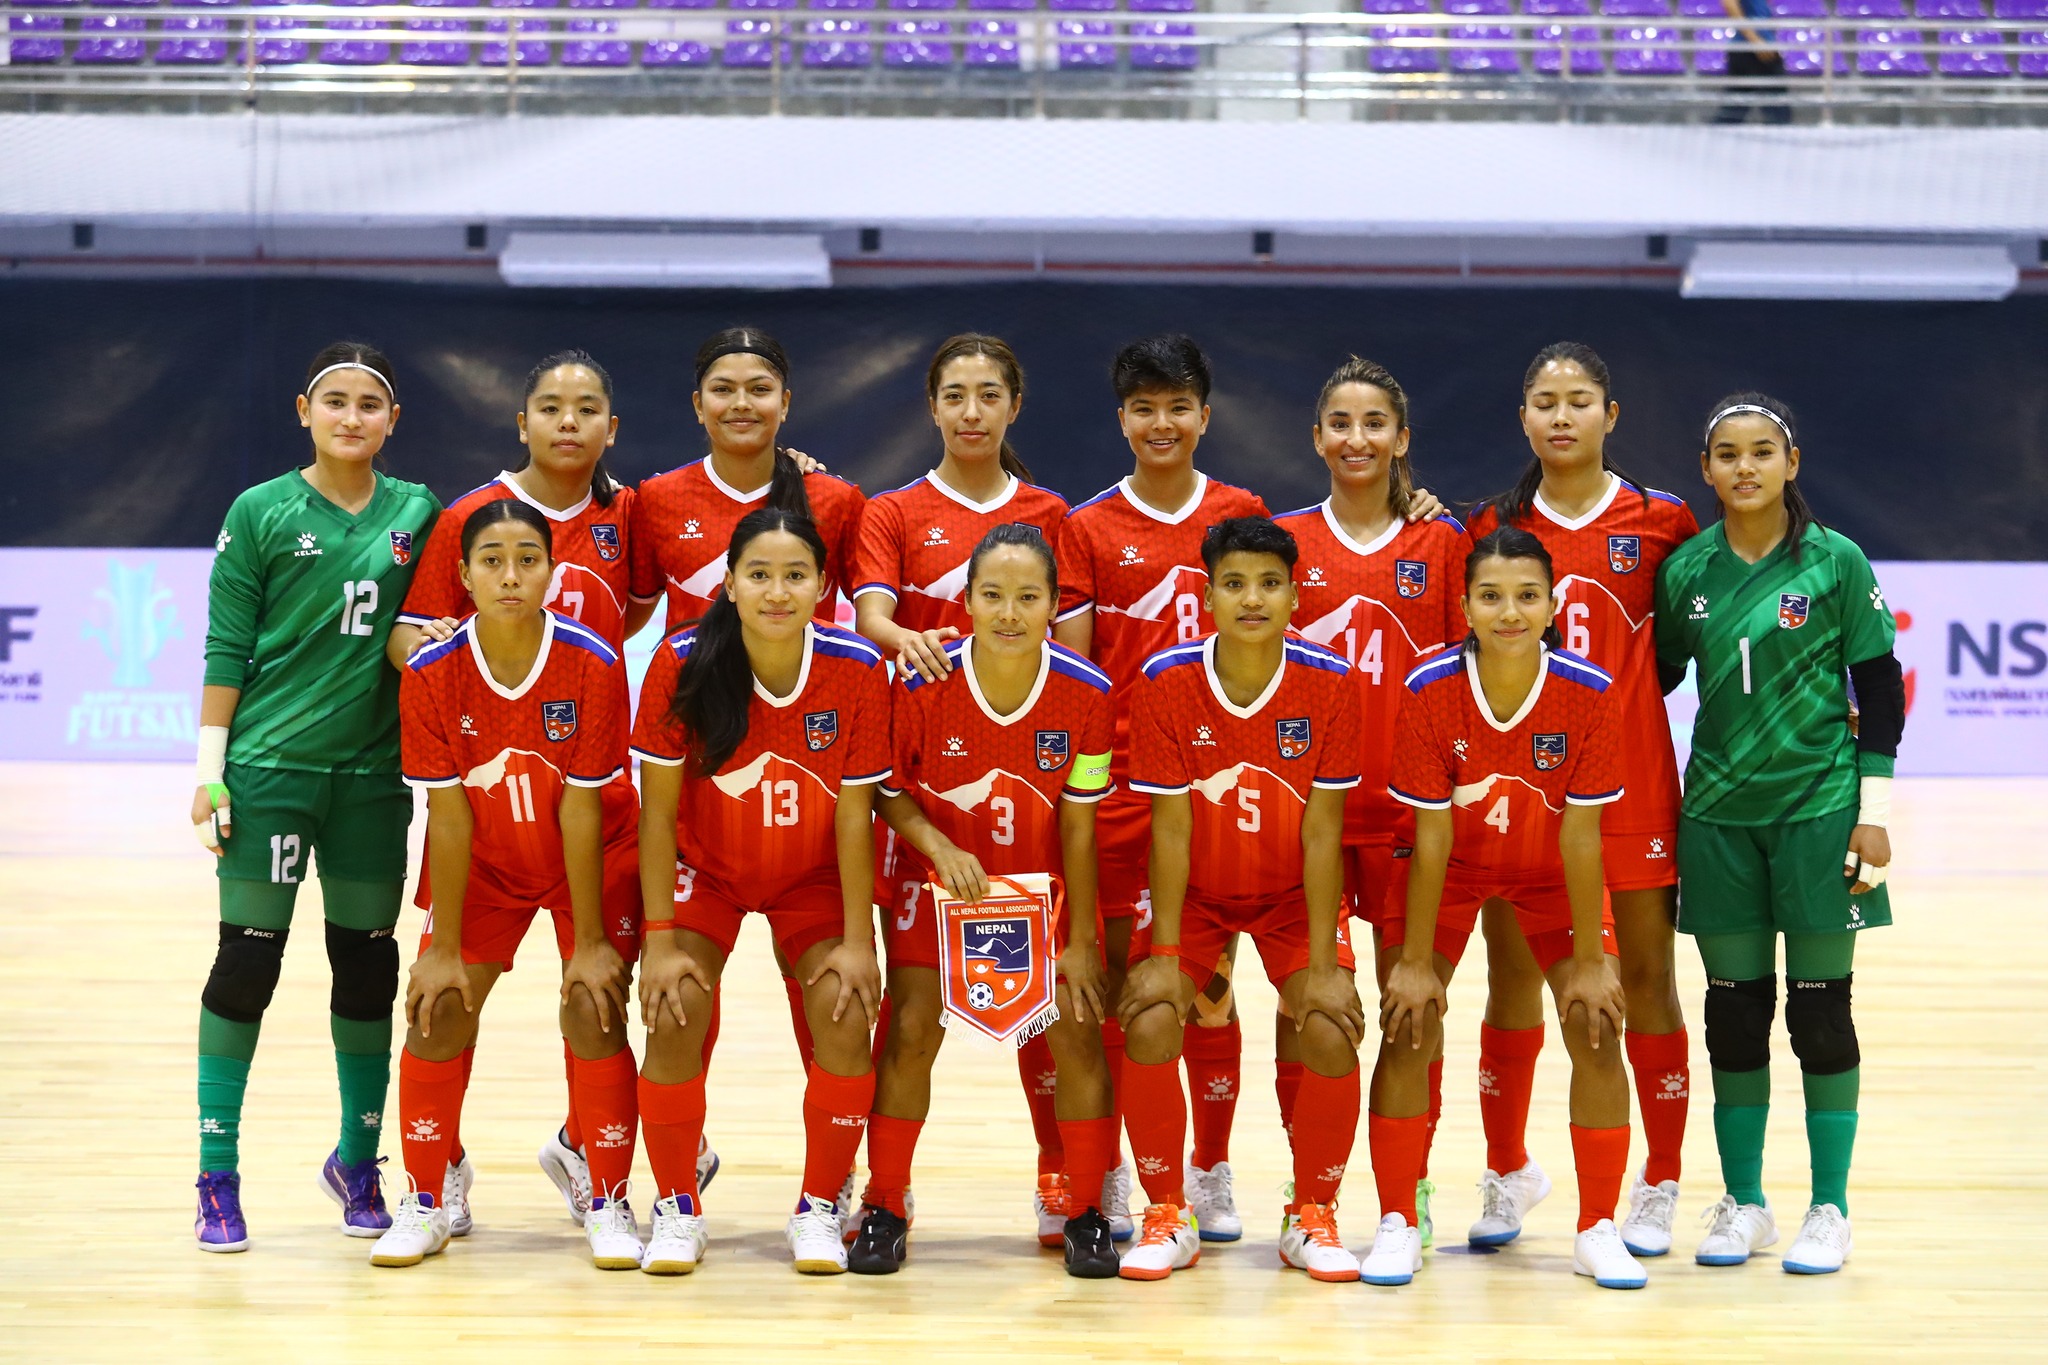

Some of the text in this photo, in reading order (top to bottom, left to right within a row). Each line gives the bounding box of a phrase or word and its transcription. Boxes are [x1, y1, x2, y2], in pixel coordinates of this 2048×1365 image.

[294, 549, 323, 557] KELME
[1119, 558, 1144, 566] KELME
[340, 580, 378, 635] 12
[563, 591, 584, 622] 7
[1176, 592, 1199, 643] 8
[1689, 612, 1709, 620] KELME
[1567, 602, 1590, 658] 6
[1948, 622, 2047, 676] NS
[1345, 628, 1383, 685] 14
[1739, 637, 1751, 694] 1
[505, 773, 536, 823] 11
[761, 779, 799, 827] 13
[1237, 786, 1260, 833] 5
[1484, 795, 1510, 834] 4
[991, 796, 1014, 845] 3
[270, 834, 300, 883] 12
[897, 882, 920, 930] 3
[1846, 920, 1866, 930] KELME
[976, 924, 1015, 934] NEPAL
[1204, 1093, 1235, 1101] KELME
[1656, 1090, 1688, 1100] KELME
[406, 1132, 441, 1142] KELME
[832, 1117, 867, 1126] KELM
[596, 1138, 630, 1147] KELME
[1139, 1165, 1170, 1176] KELME
